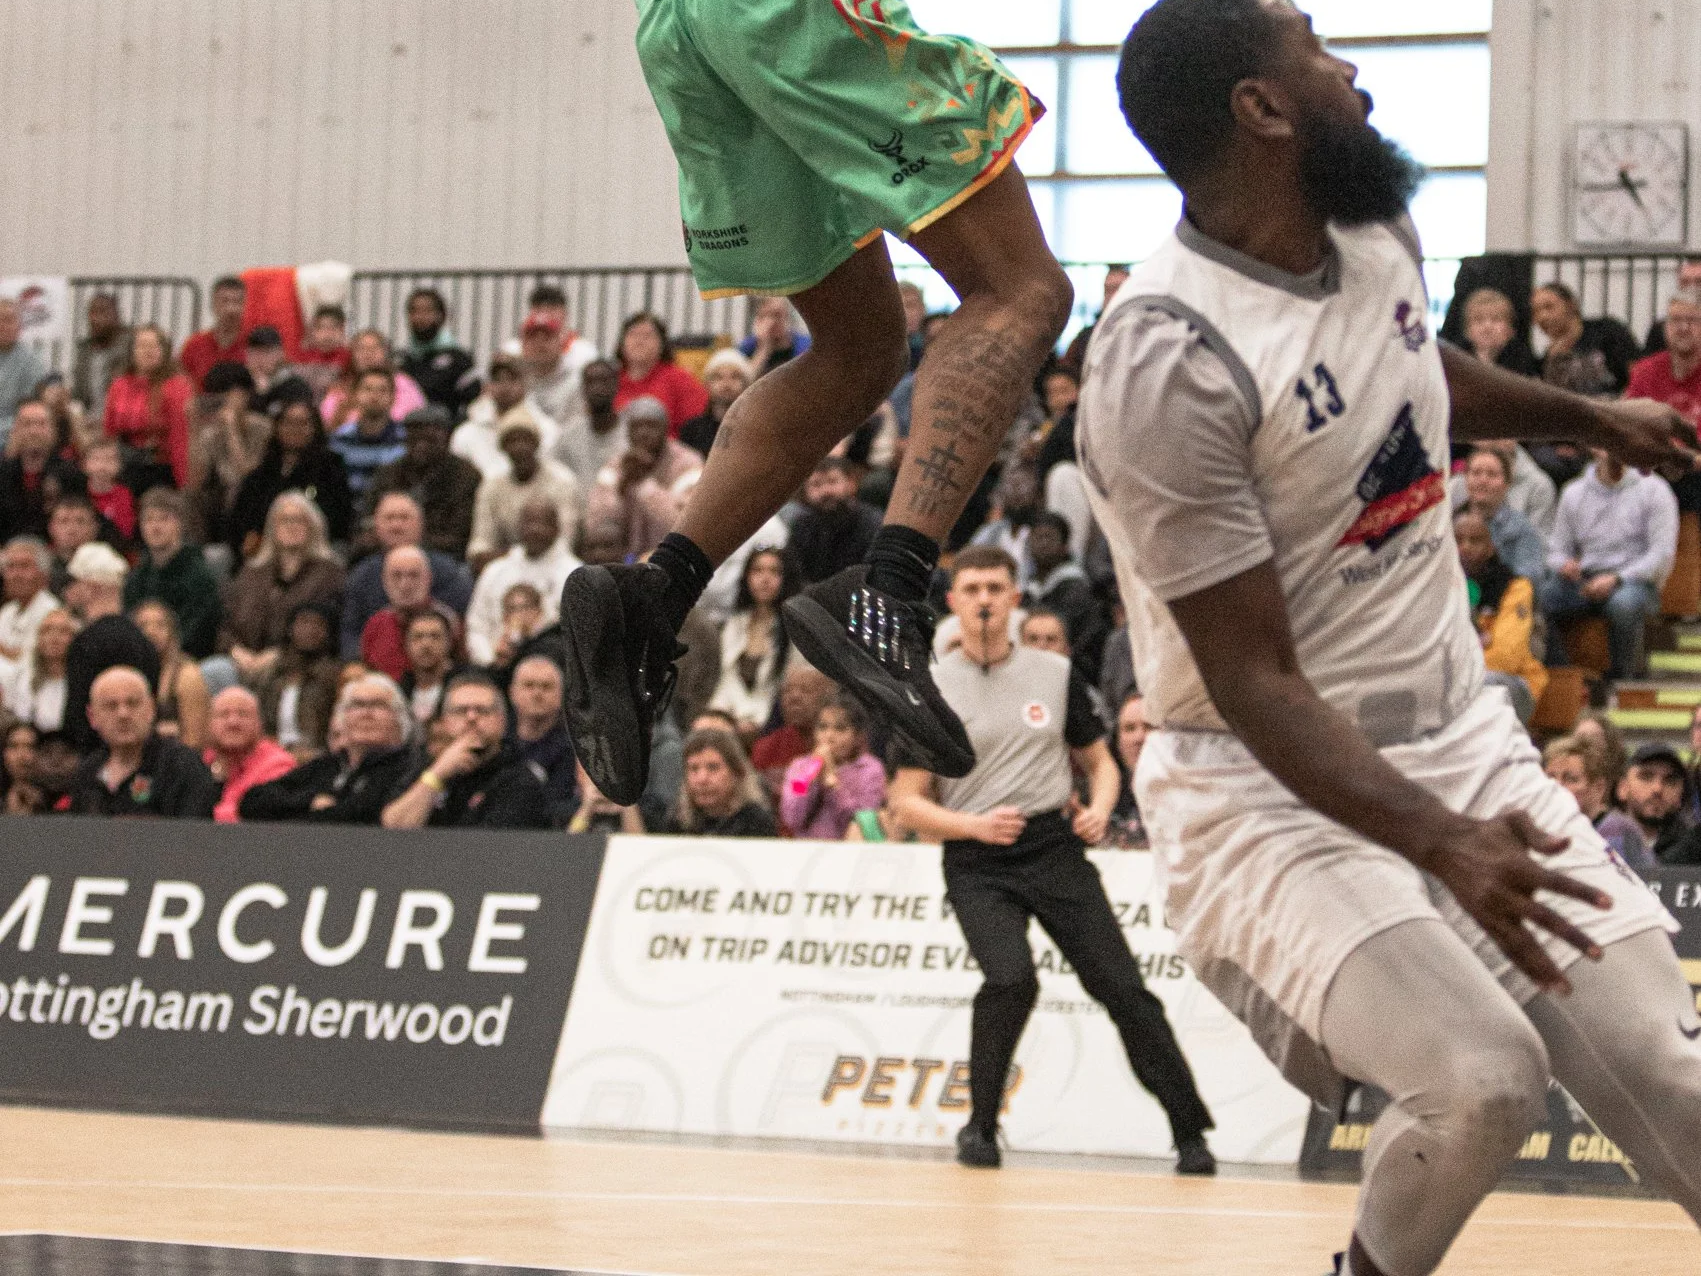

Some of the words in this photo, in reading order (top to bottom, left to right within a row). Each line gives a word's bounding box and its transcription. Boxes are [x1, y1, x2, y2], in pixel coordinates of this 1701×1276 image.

[1295, 361, 1346, 433] 13
[634, 887, 719, 914] COME
[728, 890, 793, 917] AND
[803, 892, 861, 919] TRY
[871, 894, 930, 921] THE
[648, 935, 691, 960] ON
[702, 937, 769, 963] TRIP
[776, 939, 912, 969] ADVISOR
[0, 973, 234, 1040] ottingham
[243, 984, 513, 1047] Sherwood
